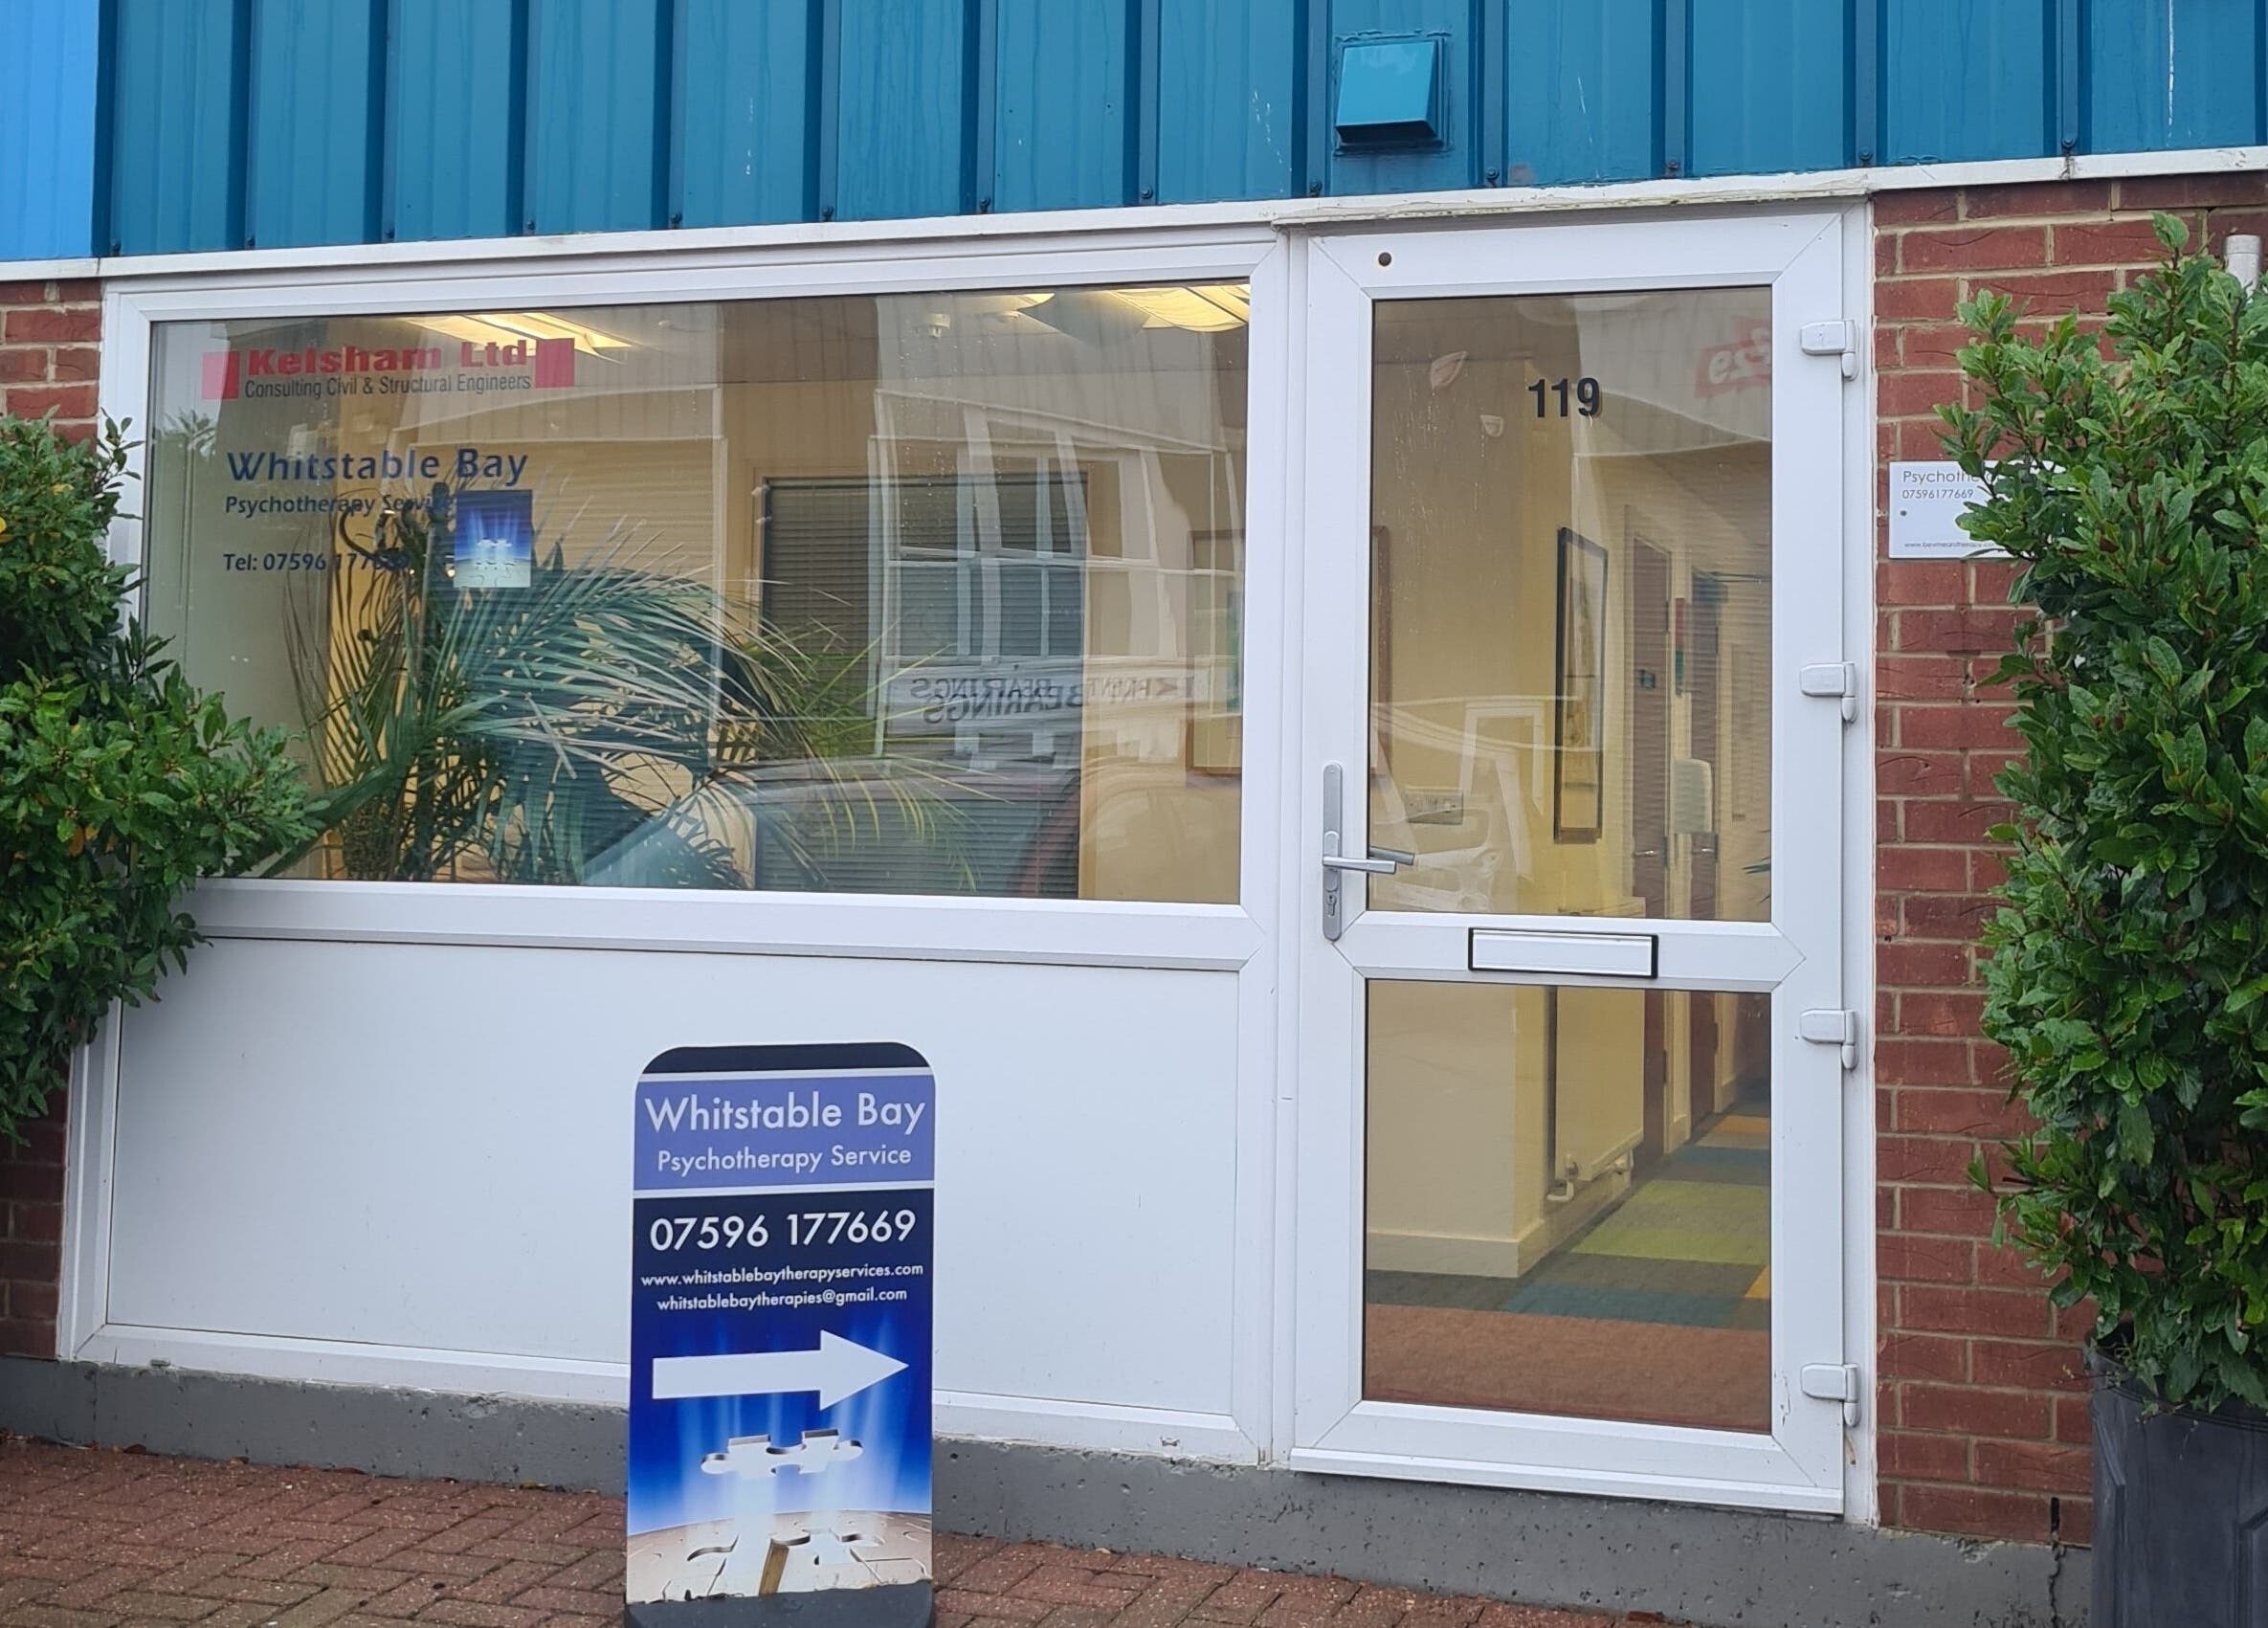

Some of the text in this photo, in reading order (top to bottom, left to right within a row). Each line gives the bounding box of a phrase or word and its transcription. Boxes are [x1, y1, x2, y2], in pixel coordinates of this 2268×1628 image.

[247, 339, 527, 376] Kelsham Ltd
[245, 372, 532, 400] Consulting Civil & Structural Engineers
[1528, 377, 1601, 418] 119
[226, 447, 529, 487] Whitstable Bay
[225, 495, 376, 518] Psychotherapy
[1901, 488, 1974, 501] 07596177669
[223, 552, 257, 571] Tel:
[263, 552, 327, 571] 07596
[644, 1090, 926, 1135] Whitstable Bay
[657, 1144, 912, 1177] Psychotherapy Service
[650, 1209, 917, 1251] 07596 177669
[640, 1263, 924, 1286] www.whitstablebaytherapyservices.com
[656, 1287, 908, 1310] whitstablebaytherapies@gmail.com
